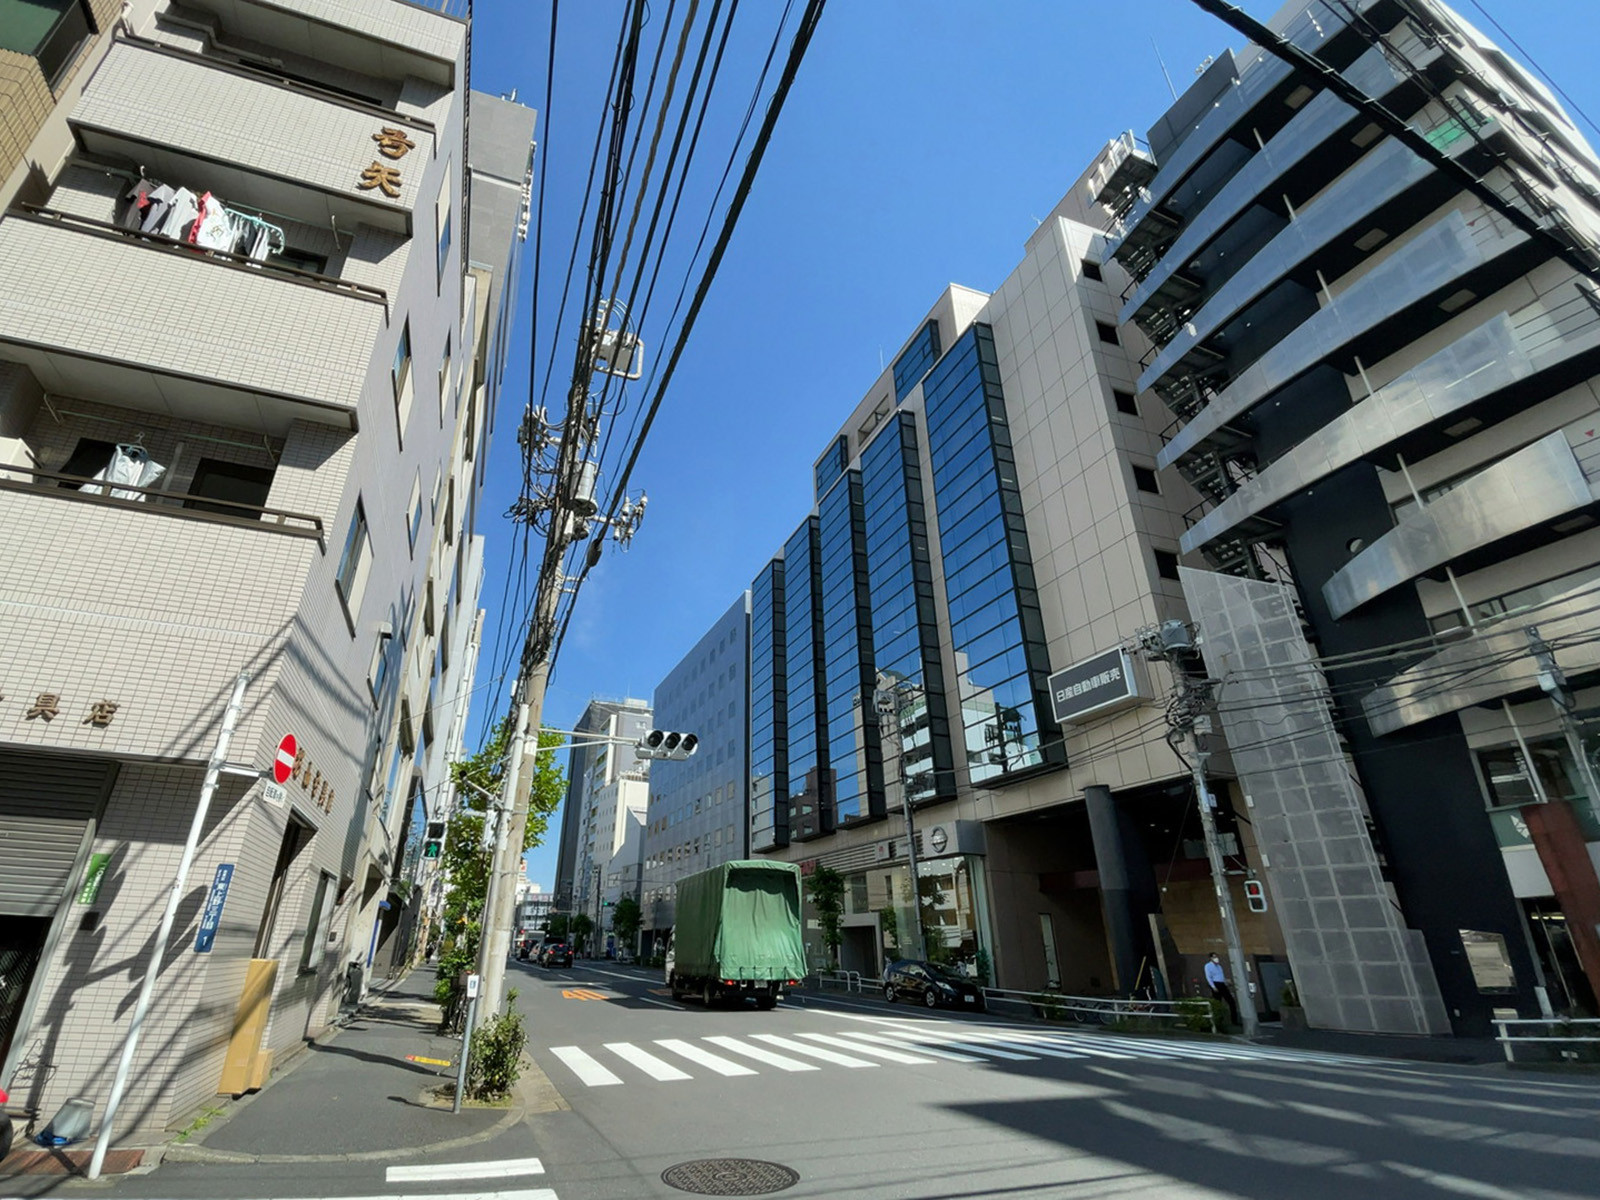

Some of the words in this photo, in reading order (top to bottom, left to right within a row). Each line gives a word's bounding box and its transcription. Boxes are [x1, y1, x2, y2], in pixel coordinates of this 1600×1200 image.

[1056, 667, 1121, 703] 日産自動車販売
[0, 690, 121, 727] 具店
